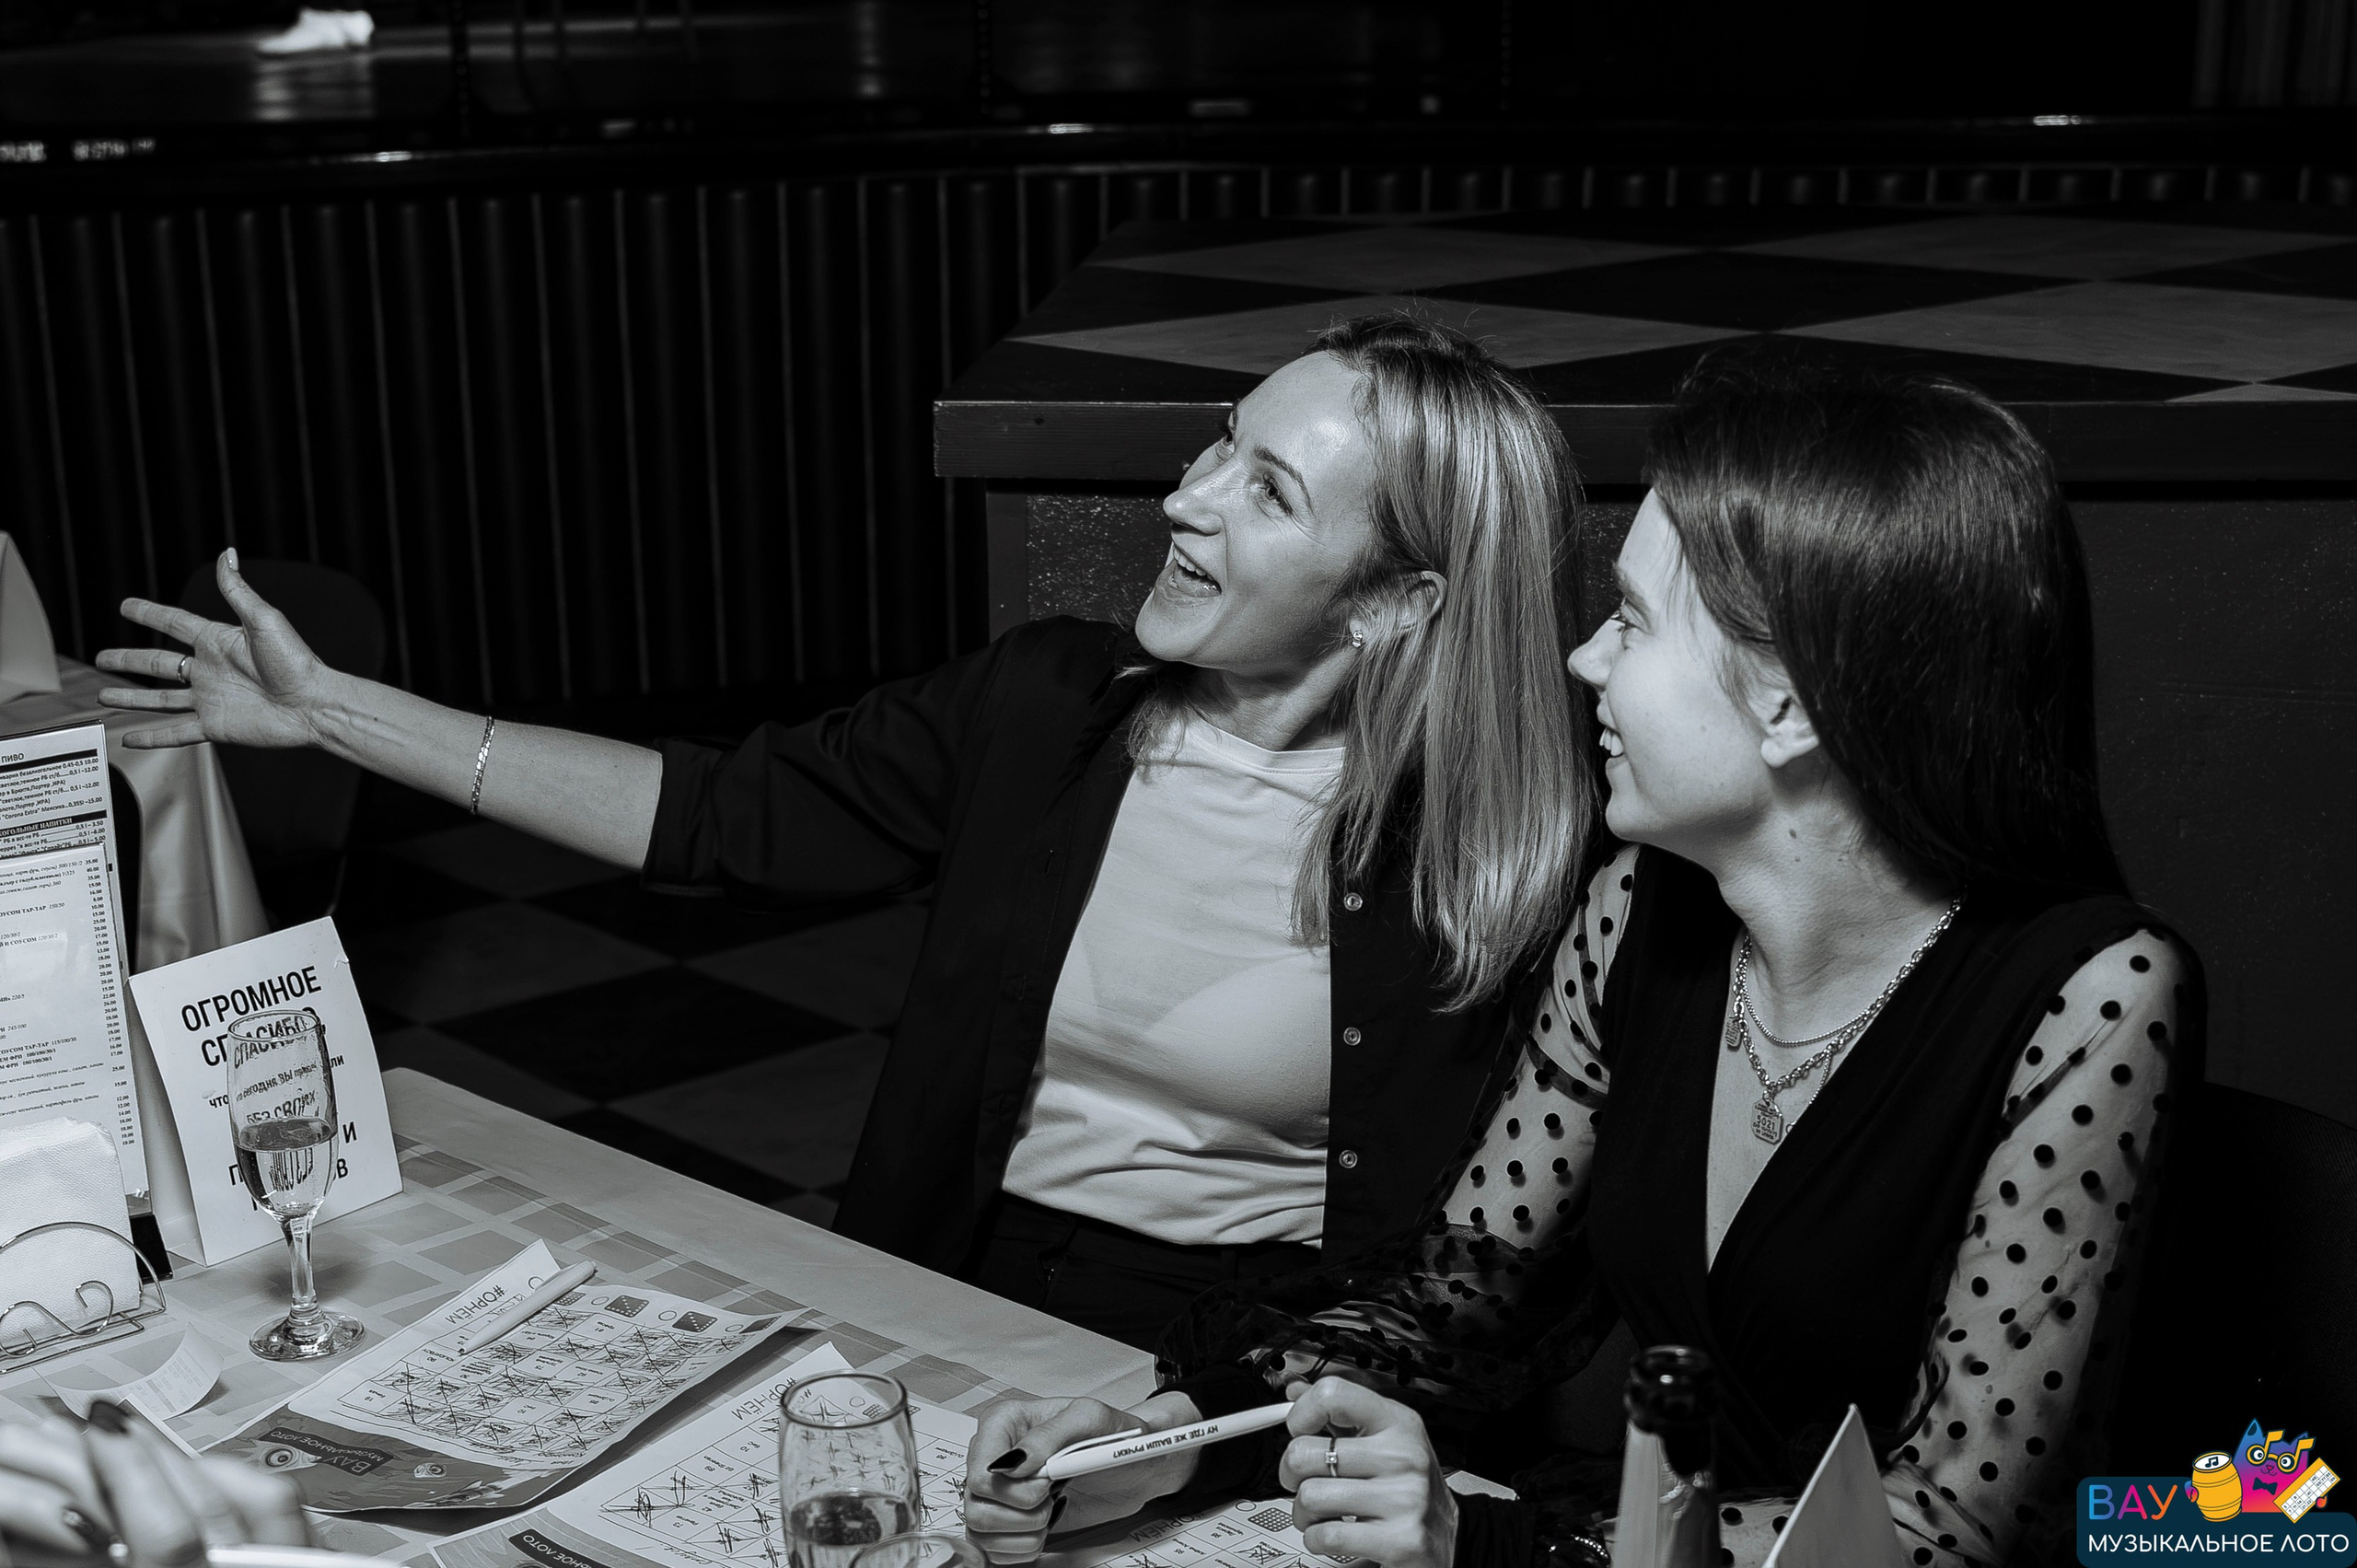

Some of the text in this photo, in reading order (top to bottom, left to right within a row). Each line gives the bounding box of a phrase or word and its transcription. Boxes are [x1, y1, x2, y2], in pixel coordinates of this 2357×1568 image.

[2, 753, 24, 763] ПИВО
[25, 807, 40, 817] Extra"
[41, 818, 73, 829] НАПИТКИ
[181, 966, 322, 1032] ОГРОМНОЕ
[25, 1042, 50, 1051] ТАР-ТАР
[209, 1095, 229, 1109] что
[1756, 1115, 1776, 1131] 5021
[444, 1284, 505, 1325] #ОРНЁМ
[271, 1430, 385, 1462] МУЗЫКАЛЬНОЕ ЛОТО
[1113, 1425, 1219, 1458] НУ ГДЕ ЖЕ ВАШИ РУЧКИ?
[322, 1456, 372, 1473] ВАУ
[703, 1456, 726, 1469] Sheeran
[523, 1535, 557, 1555] ЛОТО
